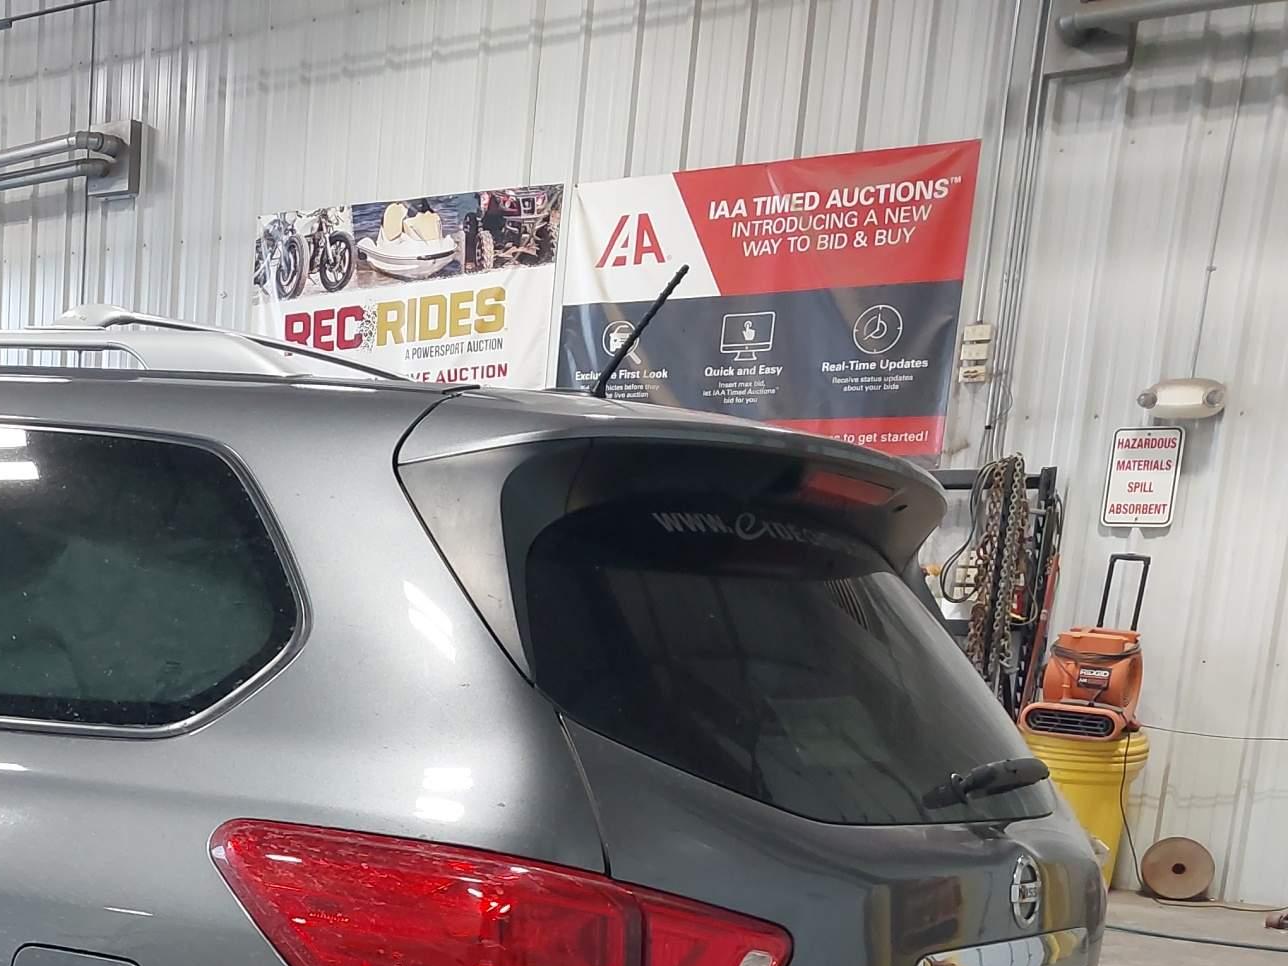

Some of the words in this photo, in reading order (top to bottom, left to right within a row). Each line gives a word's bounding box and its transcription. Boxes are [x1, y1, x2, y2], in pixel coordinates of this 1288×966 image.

[709, 197, 747, 219] IAA
[753, 191, 820, 213] TIMED
[732, 211, 858, 238] INTRODUCING
[864, 210, 878, 225] A
[885, 204, 933, 224] NEW
[743, 238, 782, 256] WAY
[789, 235, 810, 252] TO
[816, 233, 848, 250] BID
[853, 231, 868, 247] &
[875, 226, 916, 245] BUY
[285, 305, 365, 351] REC
[376, 287, 506, 346] RIDES
[405, 348, 410, 360] A
[412, 341, 464, 359] POWERSPORT
[466, 337, 503, 353] AUCTION
[704, 366, 734, 377] Quick
[737, 365, 757, 376] and
[758, 364, 783, 376] Easy
[821, 361, 877, 372] Real-Time
[879, 358, 929, 371] Updates
[436, 363, 508, 384] AUCTION
[575, 370, 617, 381] Exclue
[619, 369, 640, 379] First
[643, 368, 668, 379] Look
[843, 434, 855, 443] to
[858, 433, 877, 446] get
[880, 430, 929, 443] started!
[1117, 437, 1177, 449] HAZARDOUS
[1116, 460, 1172, 471] MATERIALS
[1127, 481, 1154, 493] SPILL
[1108, 503, 1168, 515] ABSORBENT
